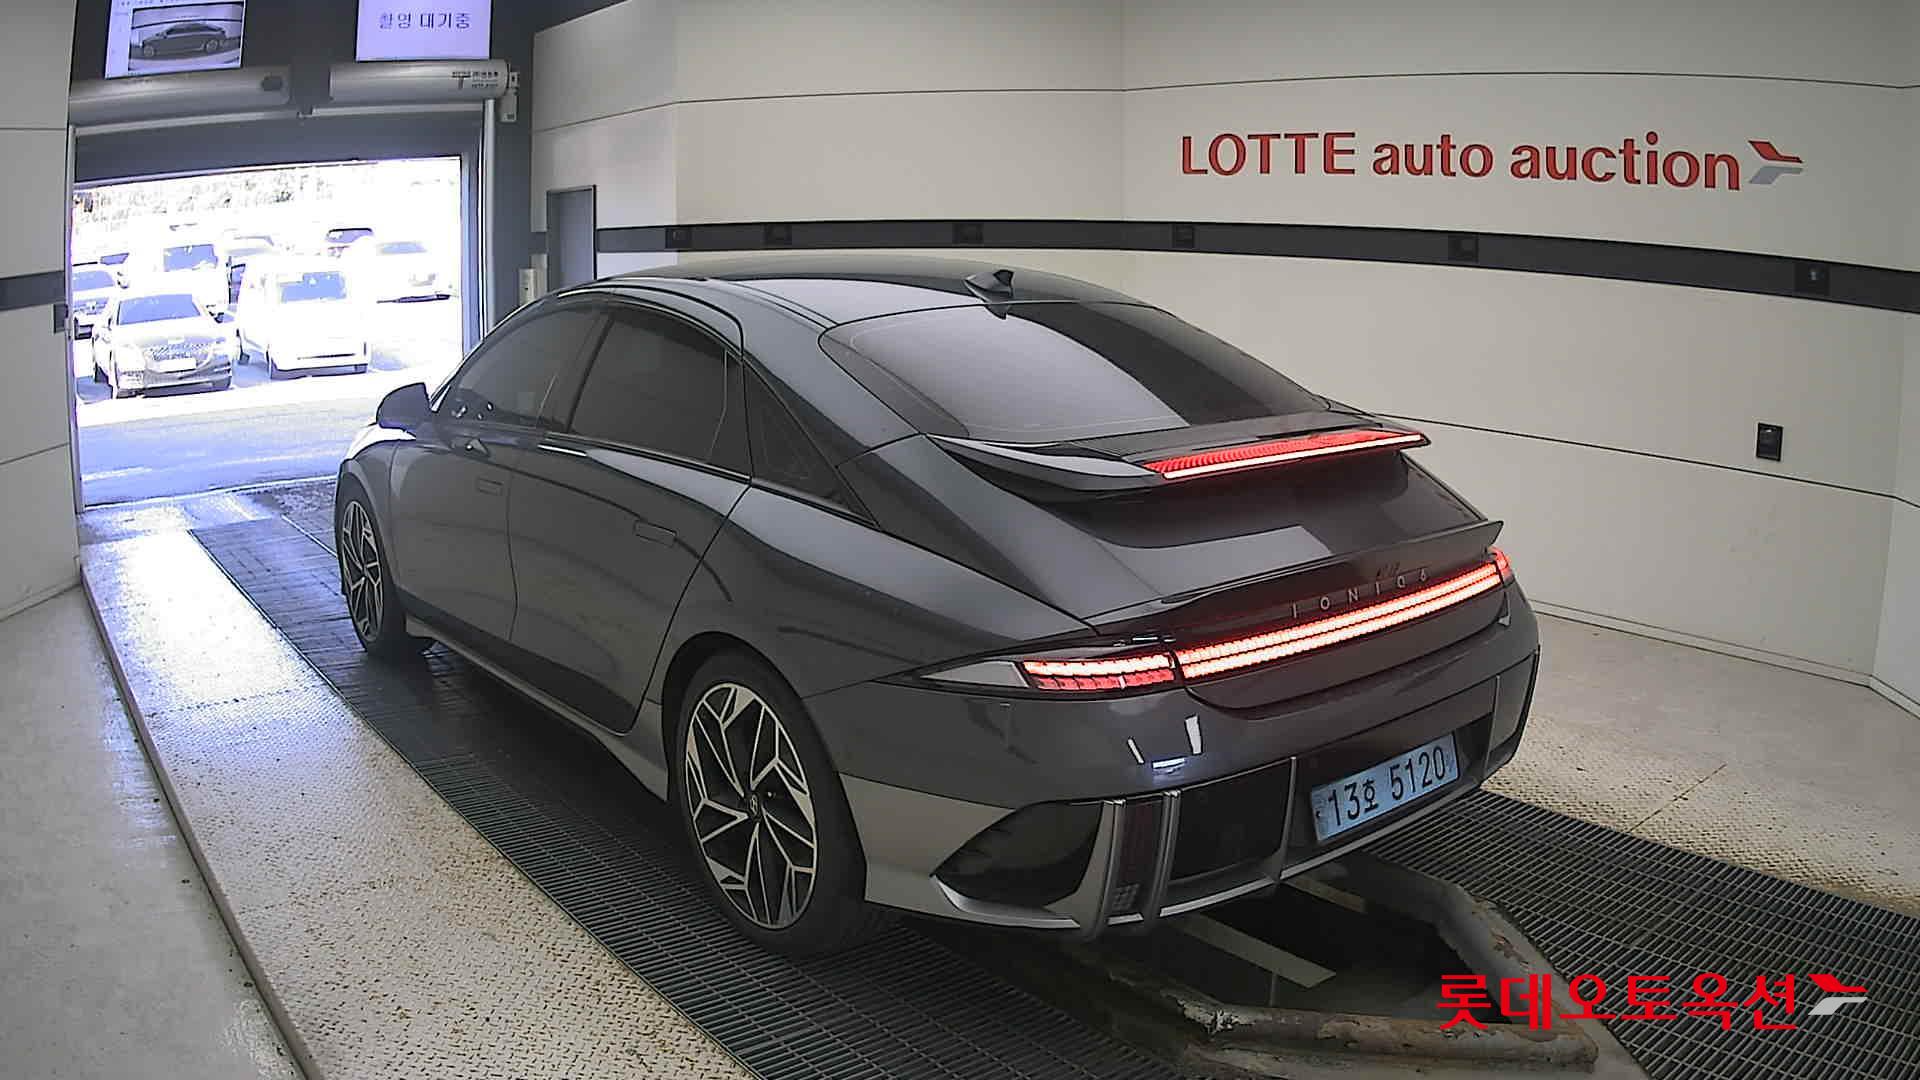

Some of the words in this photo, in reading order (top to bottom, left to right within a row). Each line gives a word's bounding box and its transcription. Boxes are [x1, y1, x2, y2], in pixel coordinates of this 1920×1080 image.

[420, 12, 471, 29] 대기중
[1181, 131, 1357, 176] LOTTE
[1372, 134, 1494, 178] auto
[1509, 131, 1741, 191] auction
[1327, 779, 1379, 827] 13호
[1389, 746, 1446, 801] 5120
